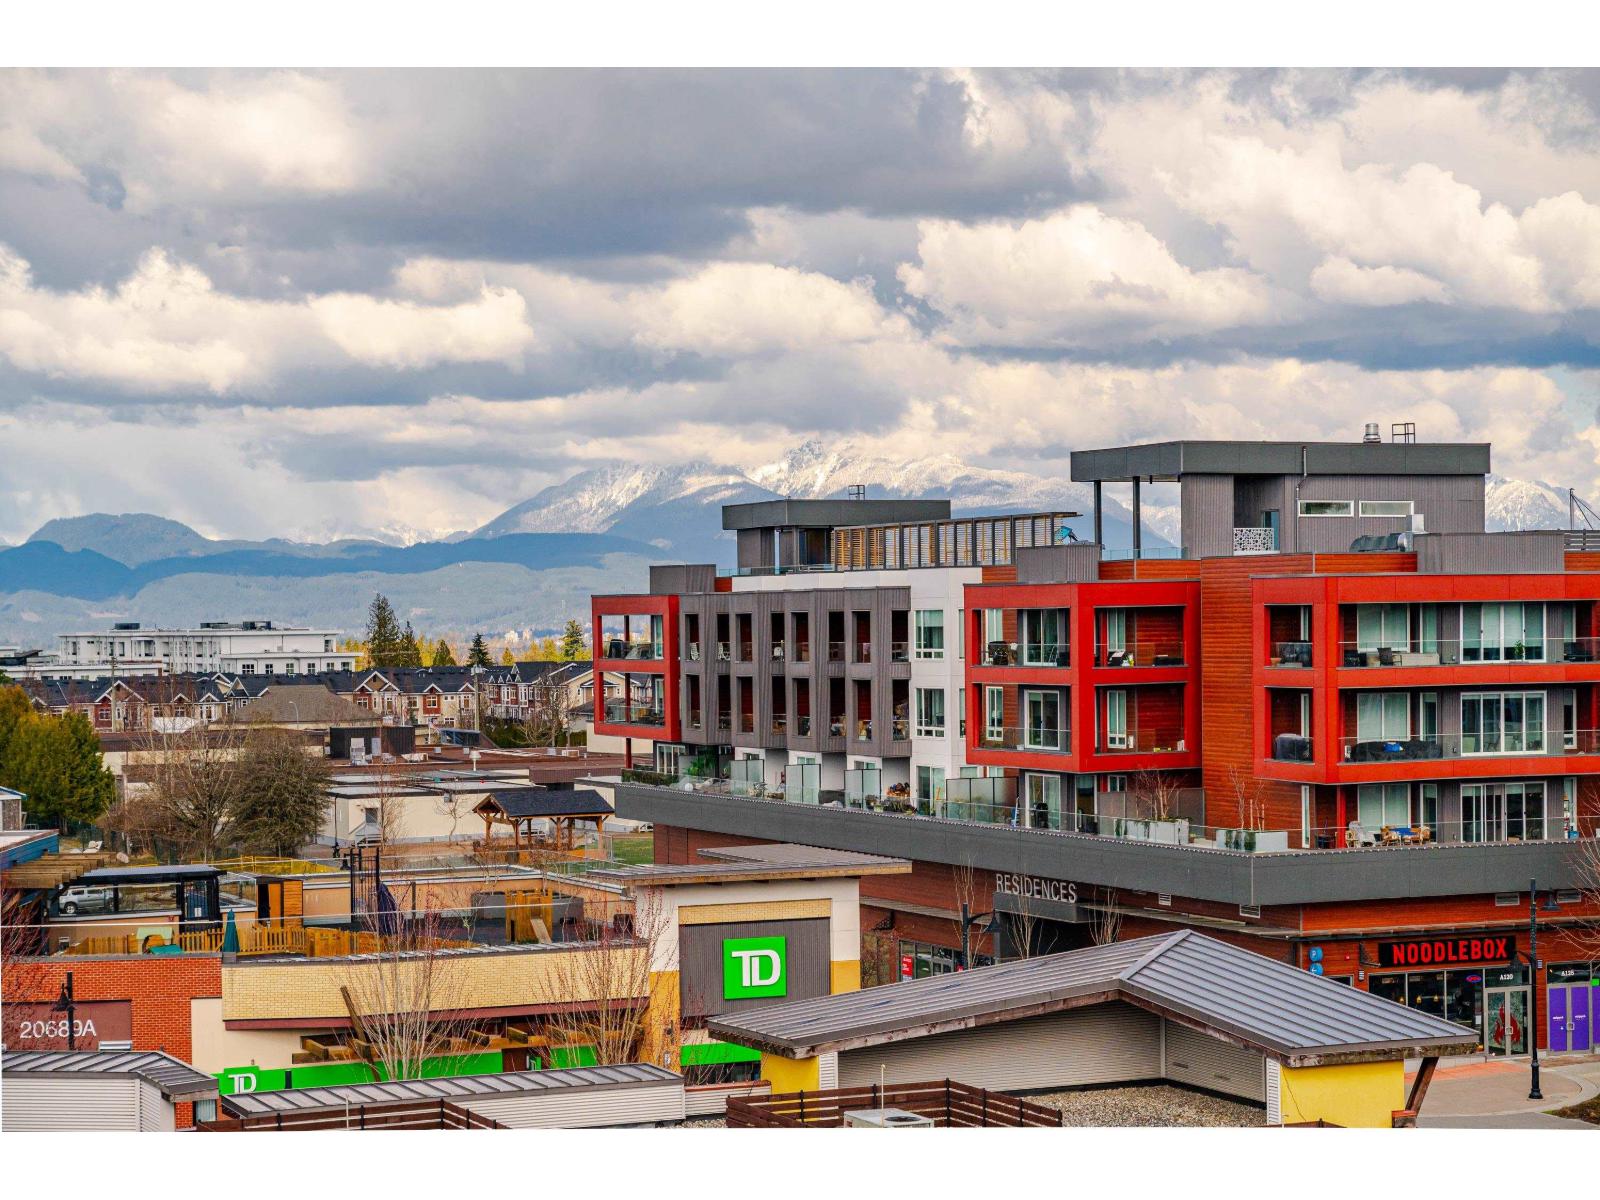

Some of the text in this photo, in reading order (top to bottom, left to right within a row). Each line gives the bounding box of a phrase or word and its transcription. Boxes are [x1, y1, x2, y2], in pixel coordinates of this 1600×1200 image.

[996, 873, 1077, 904] RESIDENCES
[1392, 938, 1508, 965] NOODLEBOX
[731, 949, 781, 987] TD
[20, 1019, 97, 1038] 20689A
[227, 1073, 257, 1094] TD
